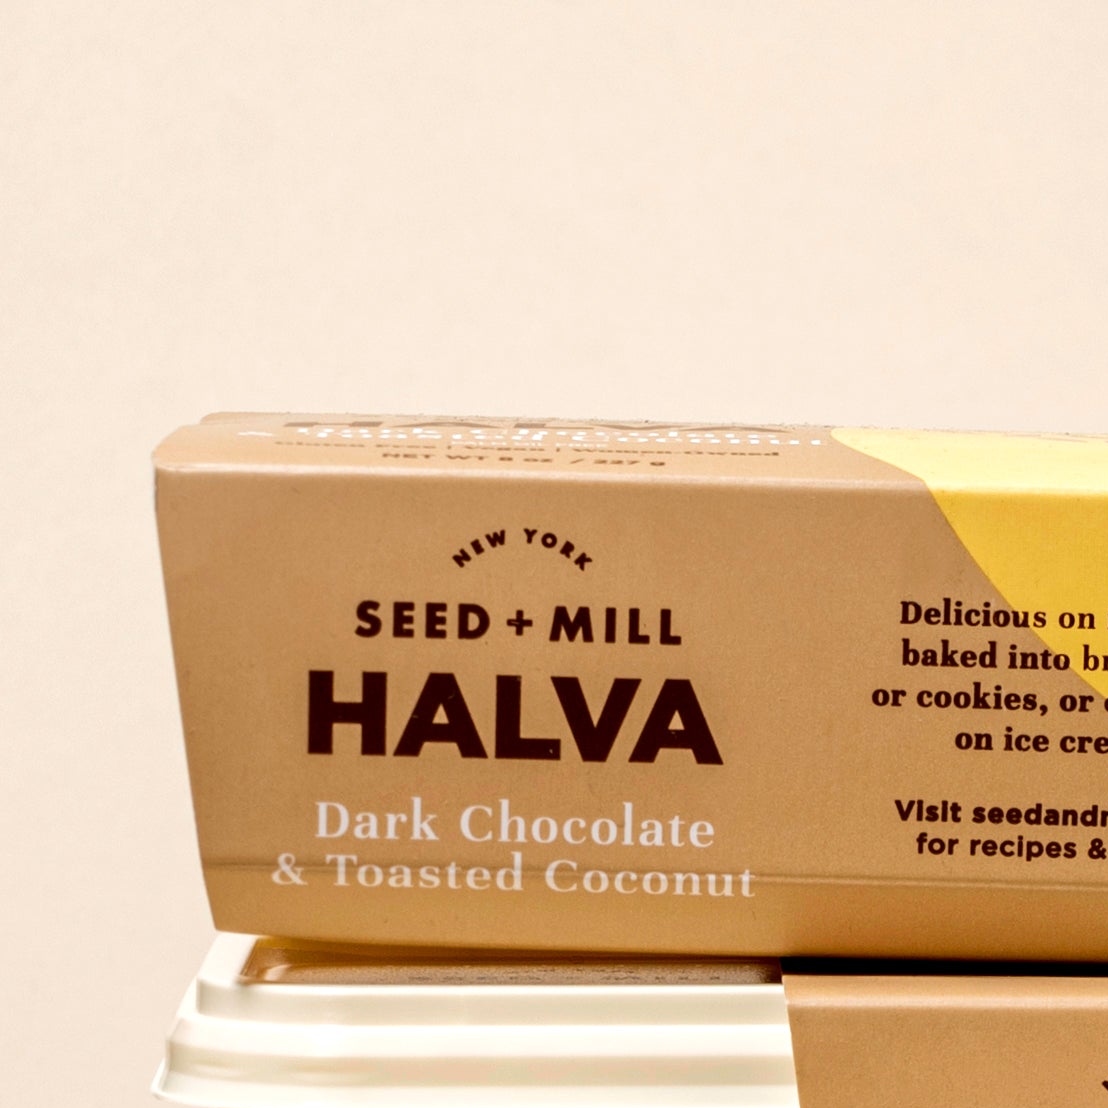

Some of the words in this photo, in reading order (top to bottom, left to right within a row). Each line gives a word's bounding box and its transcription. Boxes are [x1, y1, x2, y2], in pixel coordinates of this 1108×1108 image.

[452, 529, 506, 568] NEW
[523, 528, 593, 571] YORK
[354, 600, 491, 640] SEED
[506, 609, 533, 636] +
[549, 605, 682, 646] MILL
[899, 597, 1047, 629] Delicious
[1058, 612, 1096, 630] on
[901, 637, 998, 669] baked
[1007, 643, 1071, 671] into
[871, 688, 907, 707] or
[916, 681, 1048, 717] cookies,
[1059, 694, 1095, 713] or
[307, 669, 724, 766] HALVA
[954, 732, 994, 751] on
[1003, 726, 1050, 753] ice
[316, 796, 439, 841] Dark
[460, 798, 715, 848] Chocolate
[894, 799, 962, 823] Visit
[916, 831, 960, 856] for
[969, 835, 1077, 862] recipes
[1087, 837, 1107, 860] &
[271, 852, 305, 885] &
[325, 851, 523, 891] Toasted
[545, 860, 753, 897] Coconut
